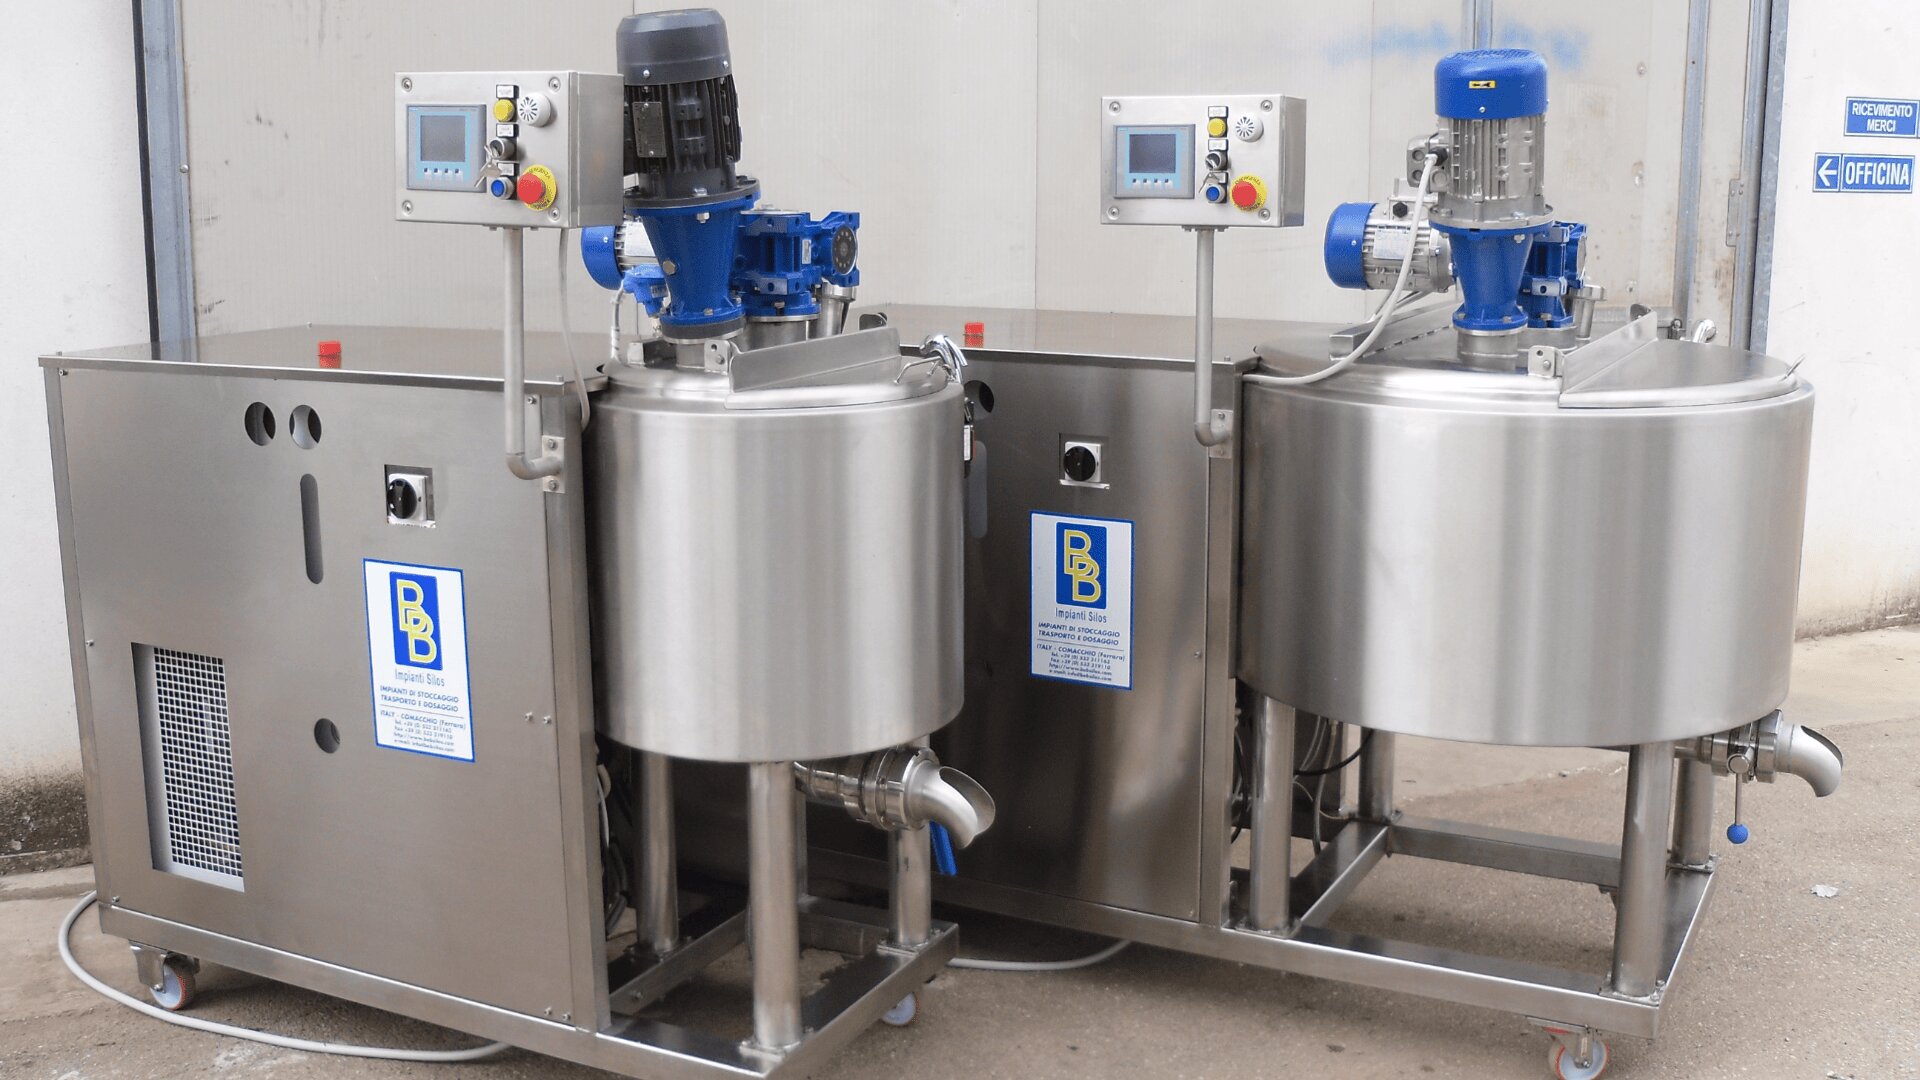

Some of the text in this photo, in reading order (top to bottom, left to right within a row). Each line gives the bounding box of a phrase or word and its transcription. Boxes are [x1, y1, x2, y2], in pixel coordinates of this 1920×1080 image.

[1852, 103, 1912, 117] RICEVIMENTO
[1867, 119, 1896, 132] MERCI
[1845, 162, 1909, 185] OFFICINA
[1056, 607, 1107, 623] Impianti Silos
[1039, 622, 1067, 630] IMPIANTI
[1078, 627, 1120, 637] STOCCAGGIO
[1039, 630, 1075, 639] TRASPORTO
[1083, 636, 1118, 645] DOSAGGIO
[1058, 647, 1096, 656] COMACCHIO
[395, 669, 444, 686] Impianti Silos
[381, 685, 407, 694] IMPIANTI
[418, 692, 459, 702] STOCCAGGIO
[381, 695, 416, 705] TRASPORTO
[424, 701, 458, 712] DOSAGGIO
[401, 714, 437, 724] COMACCHIO
